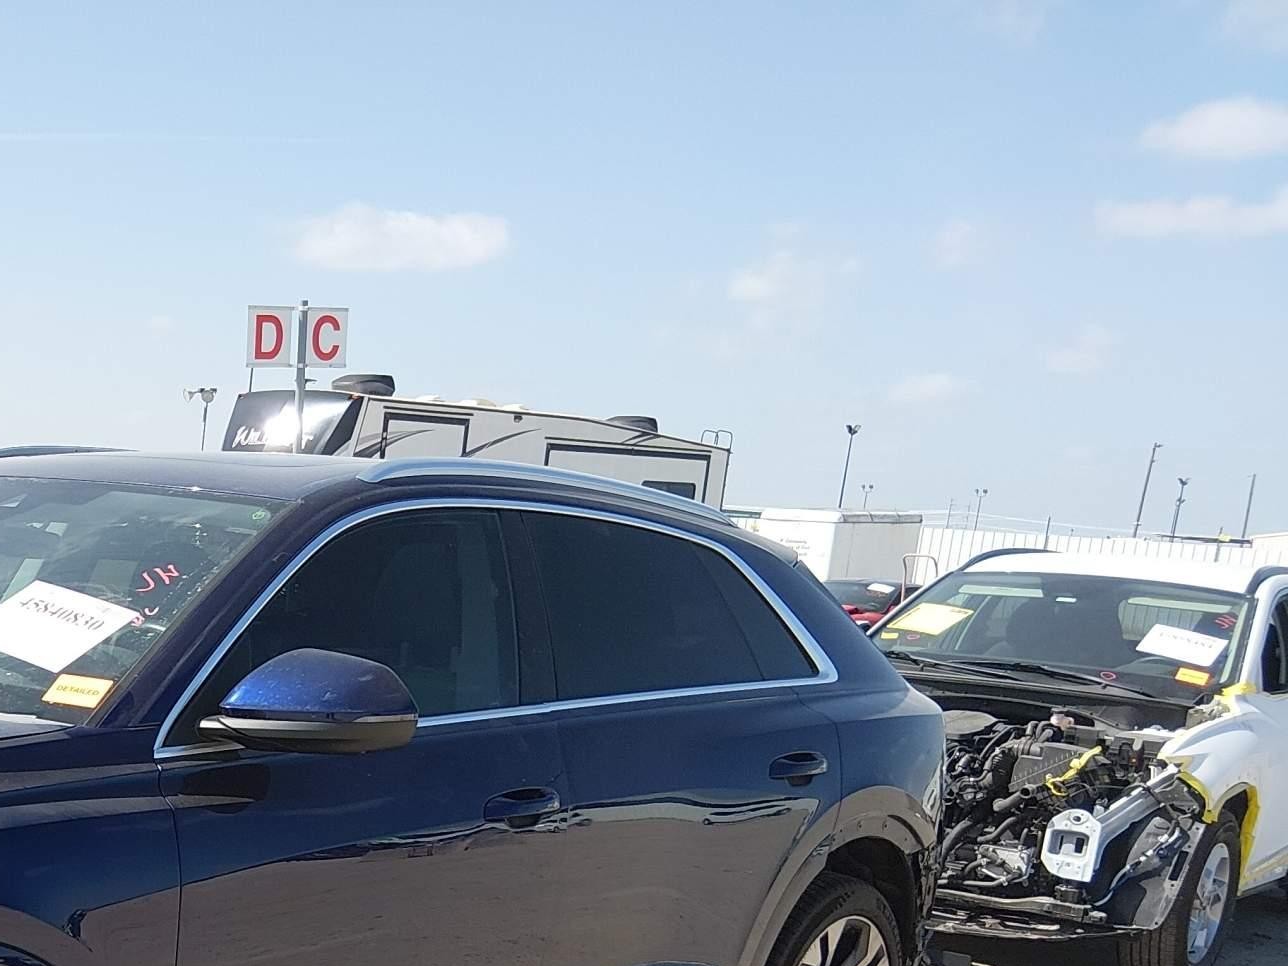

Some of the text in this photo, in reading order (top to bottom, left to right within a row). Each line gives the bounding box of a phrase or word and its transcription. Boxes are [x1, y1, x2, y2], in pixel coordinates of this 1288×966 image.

[254, 314, 284, 360] D
[311, 314, 341, 361] C
[19, 597, 105, 631] 45840830
[56, 684, 101, 696] DETAILED
